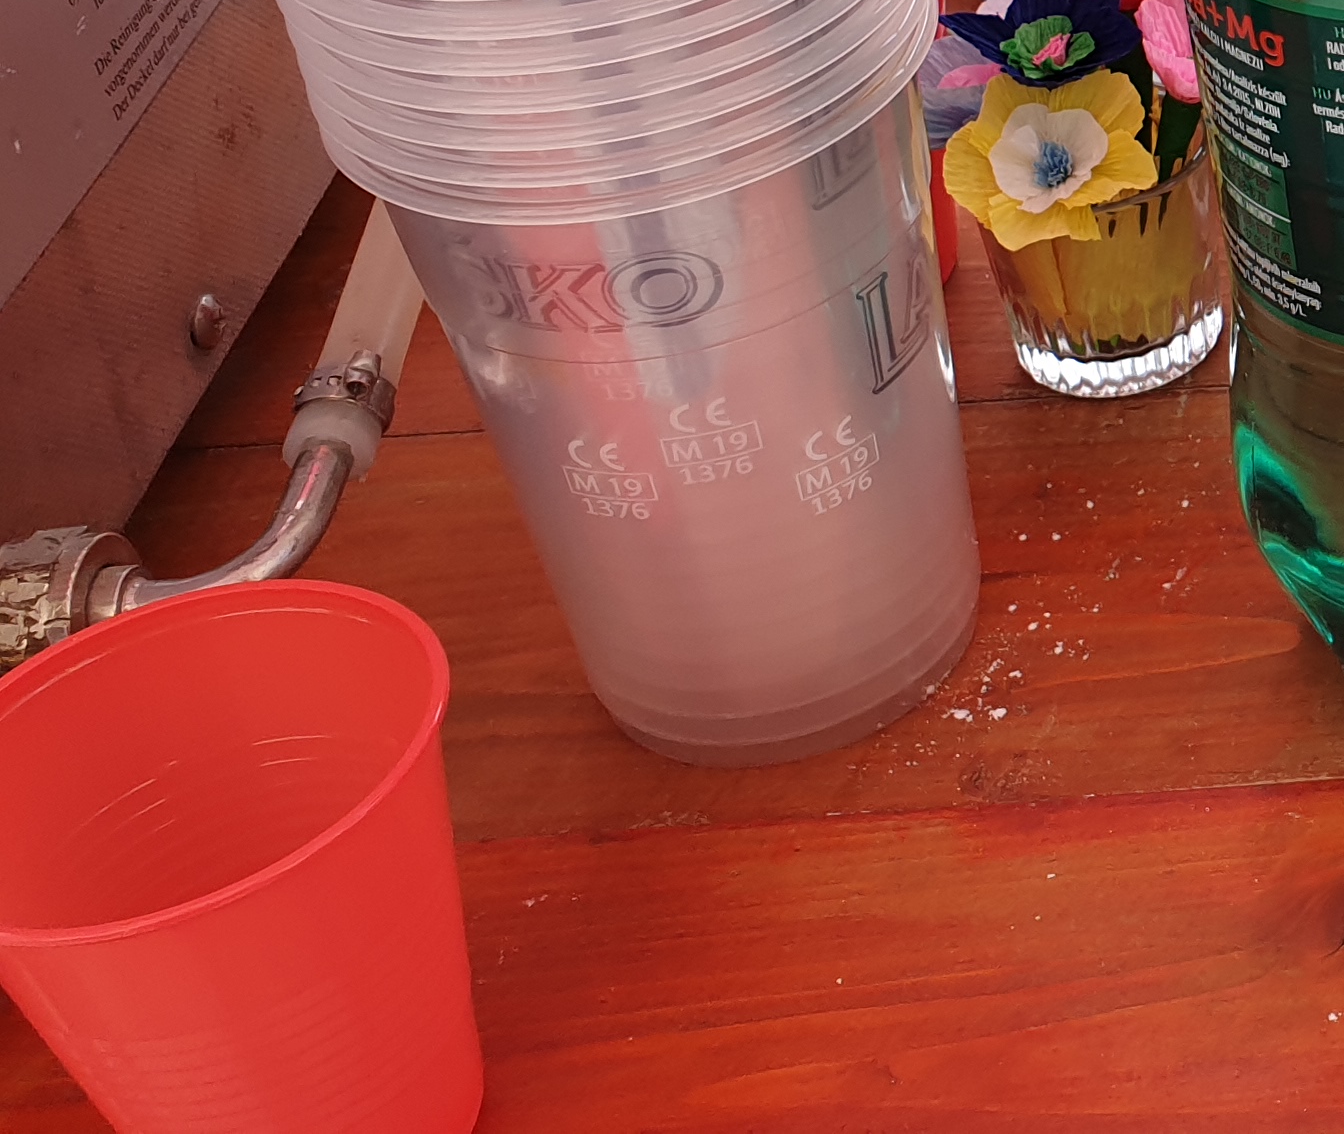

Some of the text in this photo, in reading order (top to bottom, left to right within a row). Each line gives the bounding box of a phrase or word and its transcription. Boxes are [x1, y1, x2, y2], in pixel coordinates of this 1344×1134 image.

[669, 397, 732, 434] CE
[568, 439, 626, 471] CE
[671, 431, 748, 465] M 19
[805, 415, 857, 462] CE
[572, 472, 643, 498] M 19
[678, 455, 754, 486] 1376
[803, 447, 870, 495] M 19
[582, 496, 651, 521] 1376
[811, 472, 874, 516] 1376
